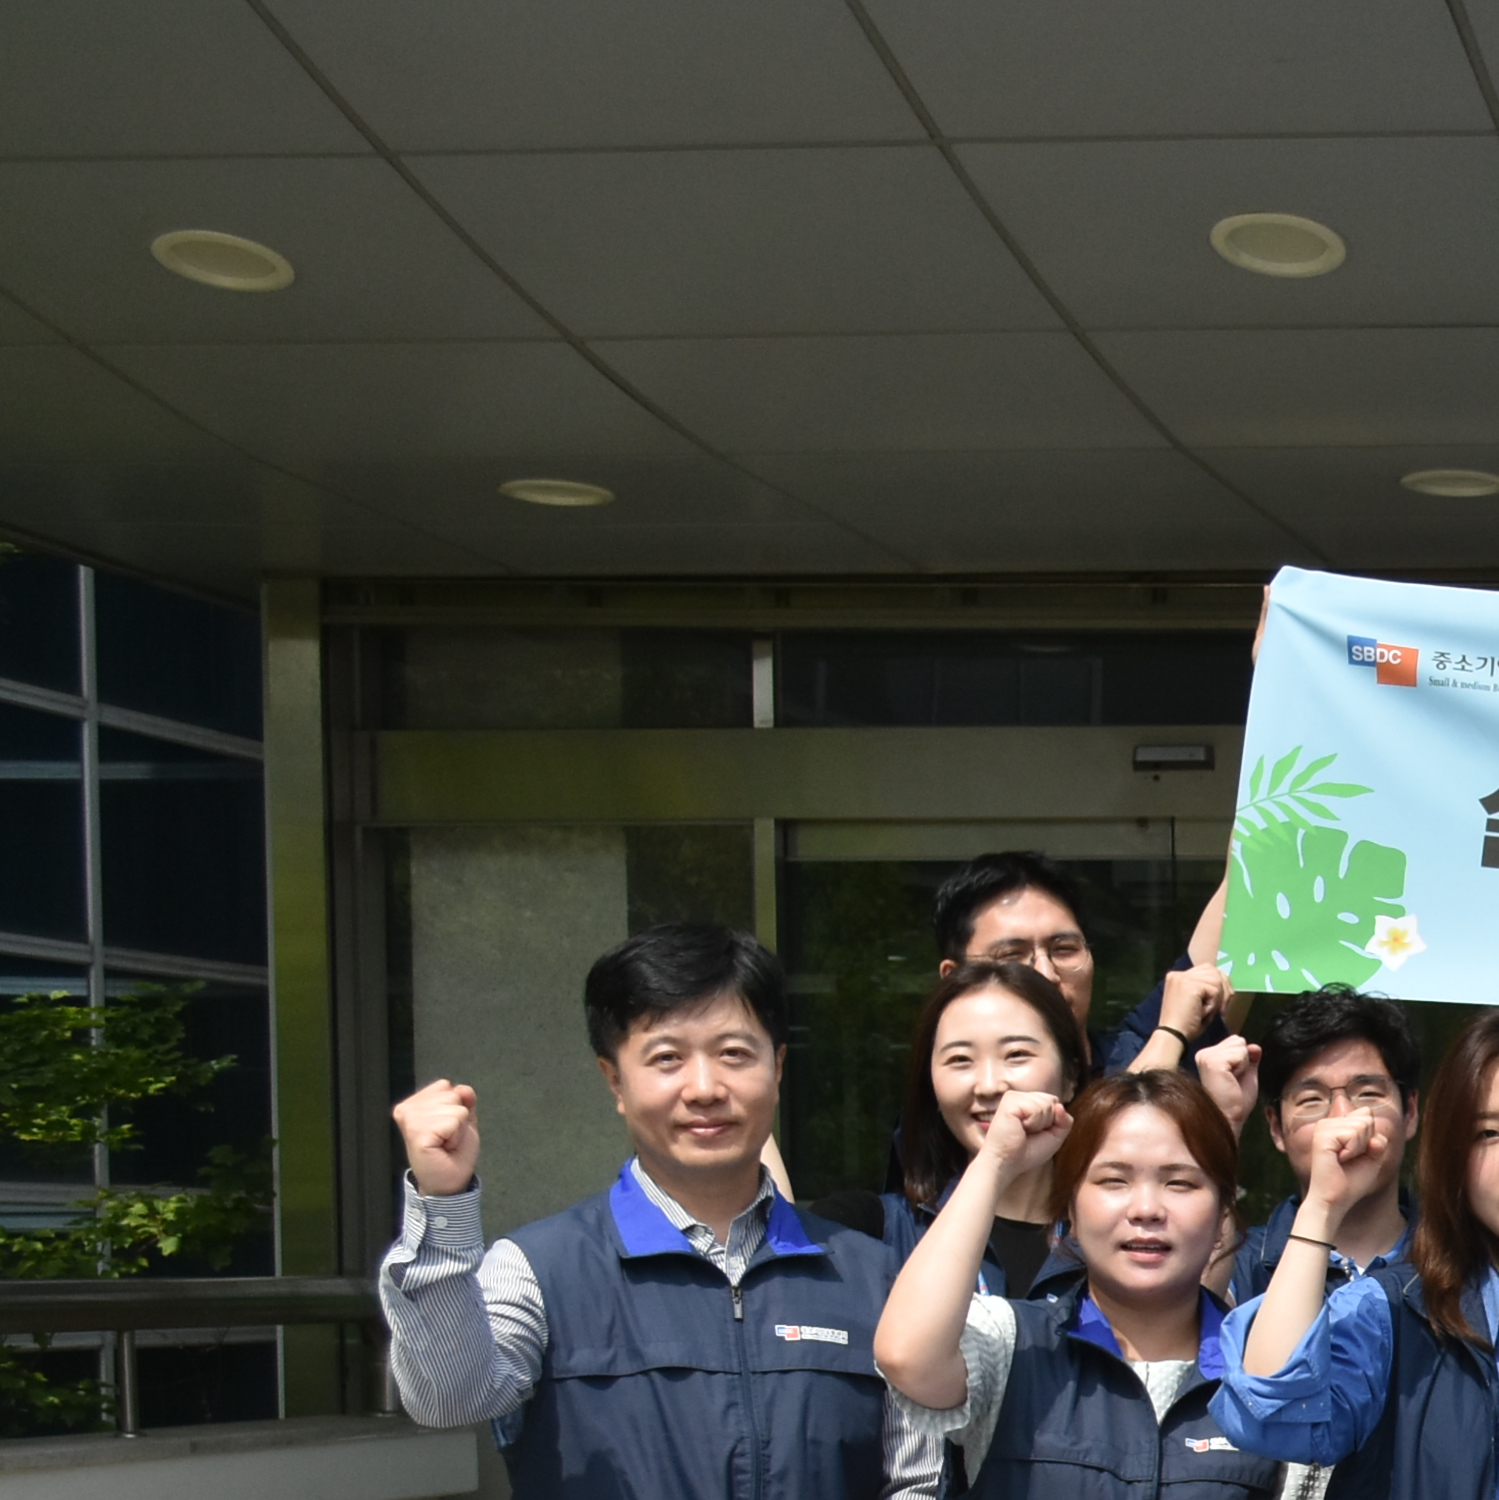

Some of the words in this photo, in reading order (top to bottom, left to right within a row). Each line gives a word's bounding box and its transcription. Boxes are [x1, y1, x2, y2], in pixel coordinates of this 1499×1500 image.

[1351, 645, 1402, 665] SBDC
[1428, 676, 1450, 688] Small
[1452, 679, 1459, 689] &
[1460, 681, 1491, 692] medium
